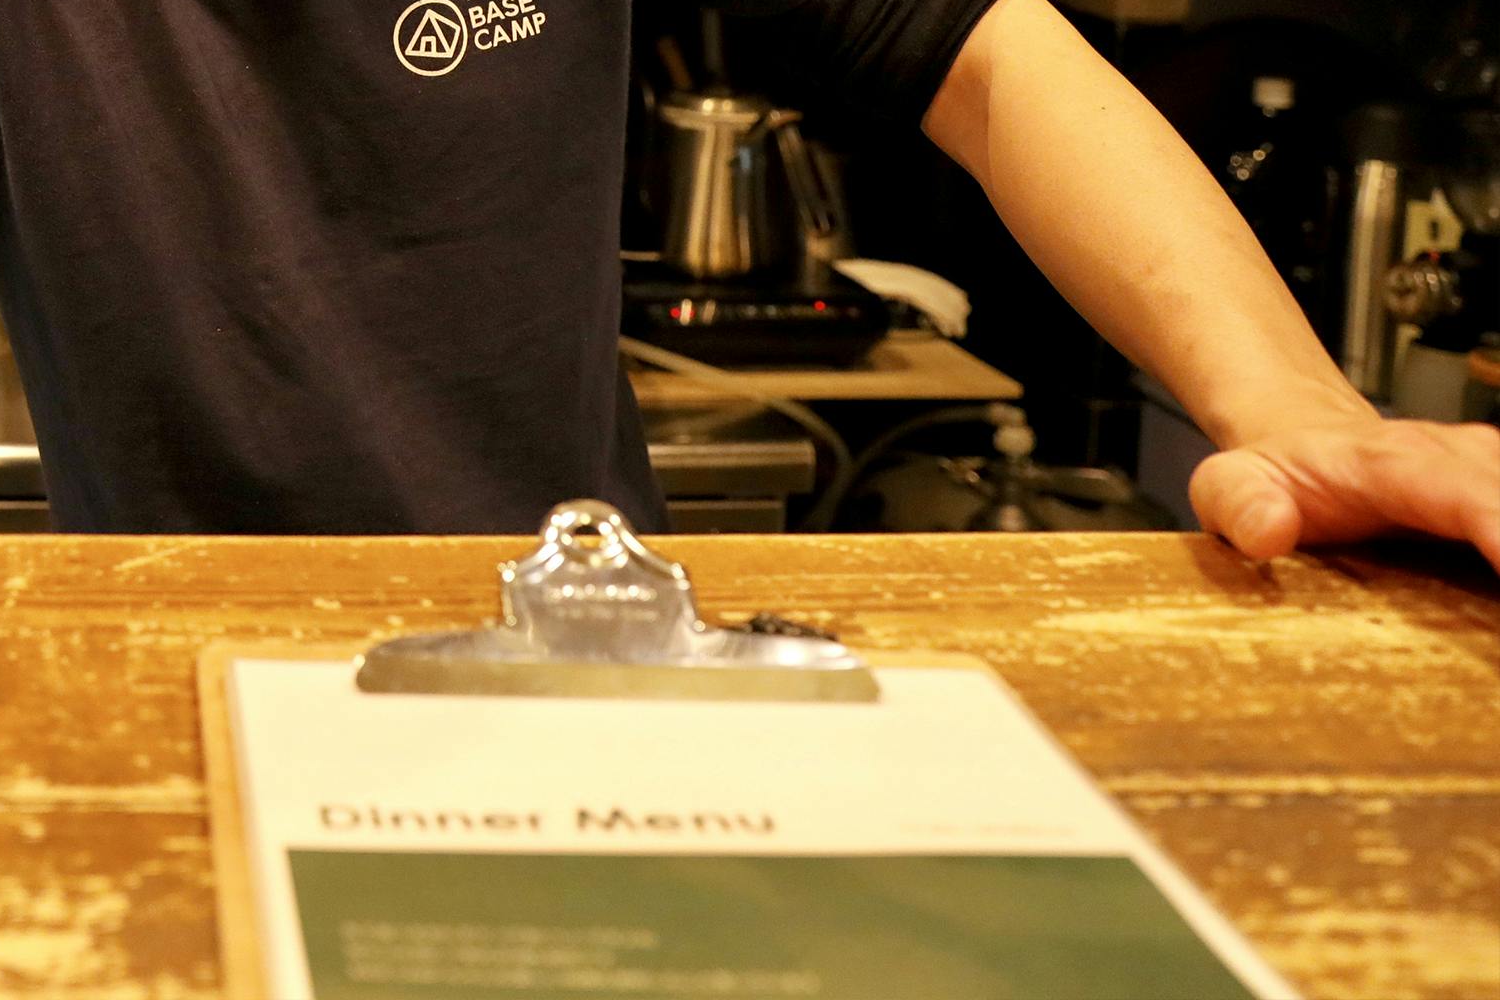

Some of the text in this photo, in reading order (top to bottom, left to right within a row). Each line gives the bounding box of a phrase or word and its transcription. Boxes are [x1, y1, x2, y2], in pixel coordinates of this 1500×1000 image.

[474, 12, 546, 50] CAMP
[318, 804, 776, 835] Dinner Menu
